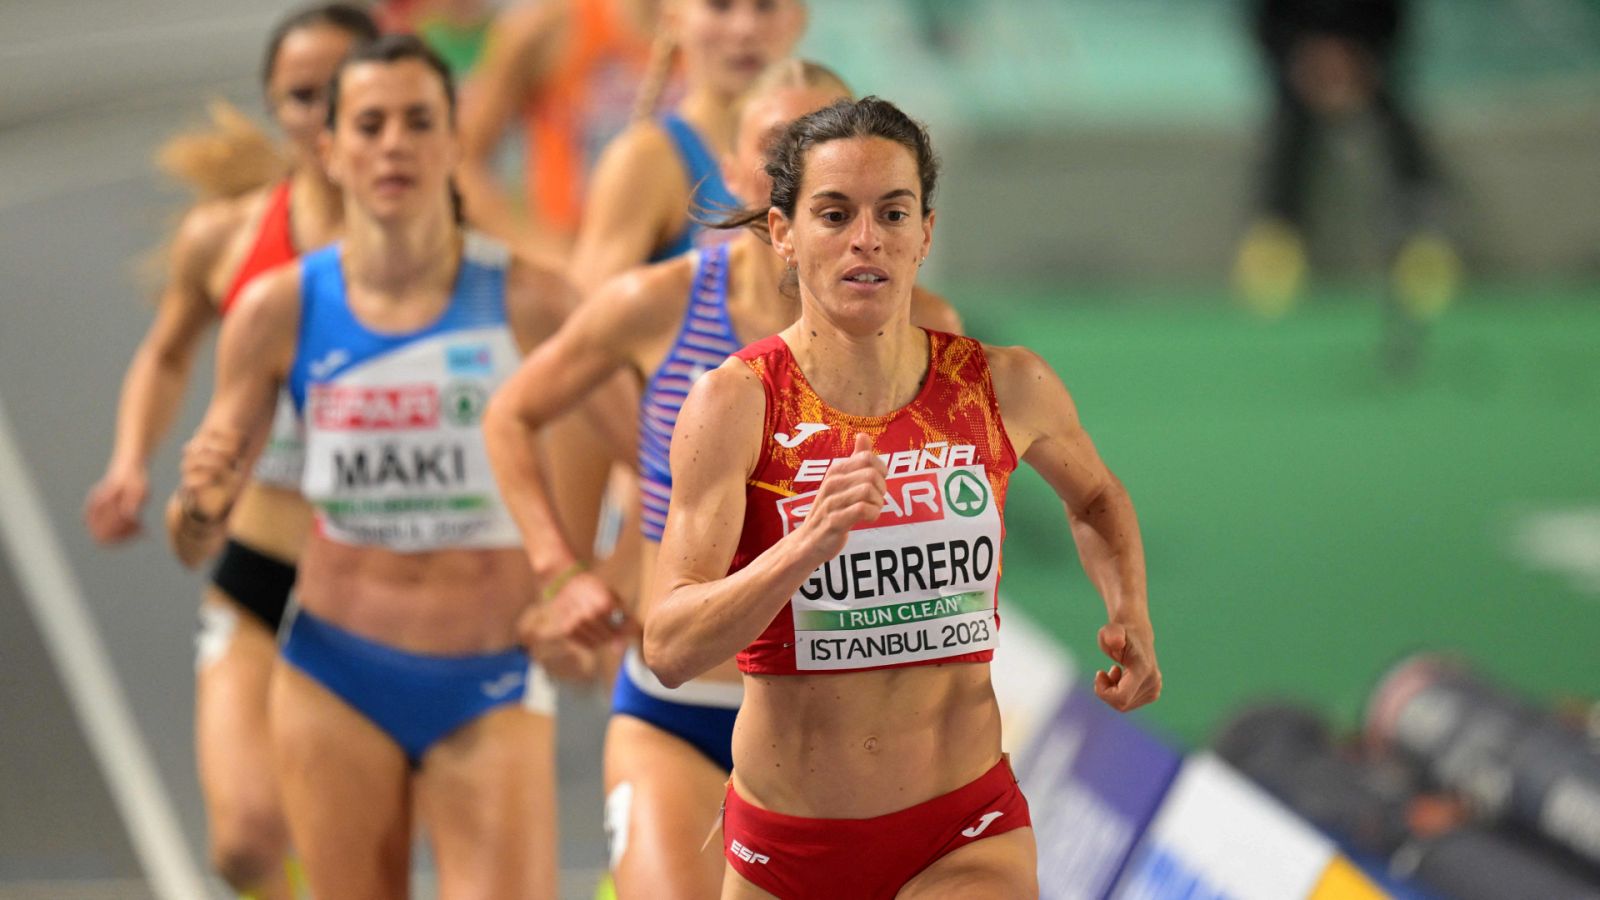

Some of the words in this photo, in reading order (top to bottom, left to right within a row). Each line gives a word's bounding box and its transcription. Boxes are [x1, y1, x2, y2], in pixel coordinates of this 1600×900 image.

[334, 444, 466, 487] MÄKI
[793, 441, 976, 482] EAÑA
[799, 535, 994, 601] GUERRERO
[839, 613, 845, 628] I
[850, 606, 893, 627] RUN
[810, 629, 938, 661] ISTANBUL
[941, 619, 990, 648] 2023
[730, 839, 770, 865] ESP
